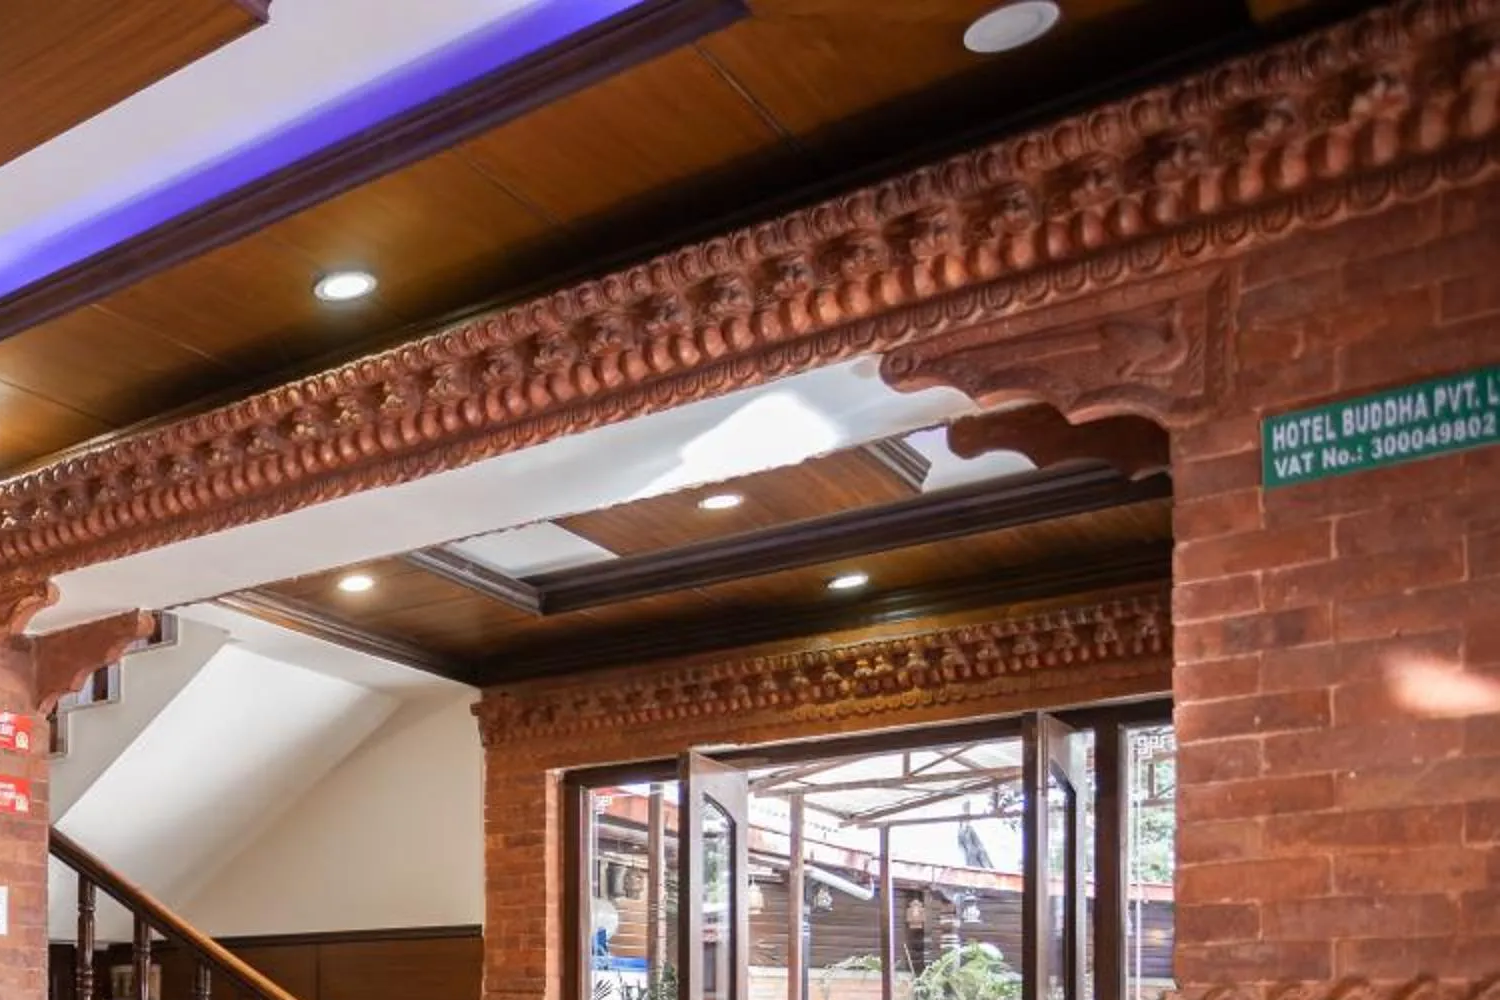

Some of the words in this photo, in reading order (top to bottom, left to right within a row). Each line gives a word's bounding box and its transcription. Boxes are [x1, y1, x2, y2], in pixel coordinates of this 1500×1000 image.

[1273, 415, 1336, 453] HOTEL
[1342, 393, 1428, 437] BUDDHA
[1433, 377, 1481, 417] PVT.
[1487, 374, 1500, 406] L
[1274, 451, 1314, 480] VAT
[1371, 412, 1496, 460] 300049802
